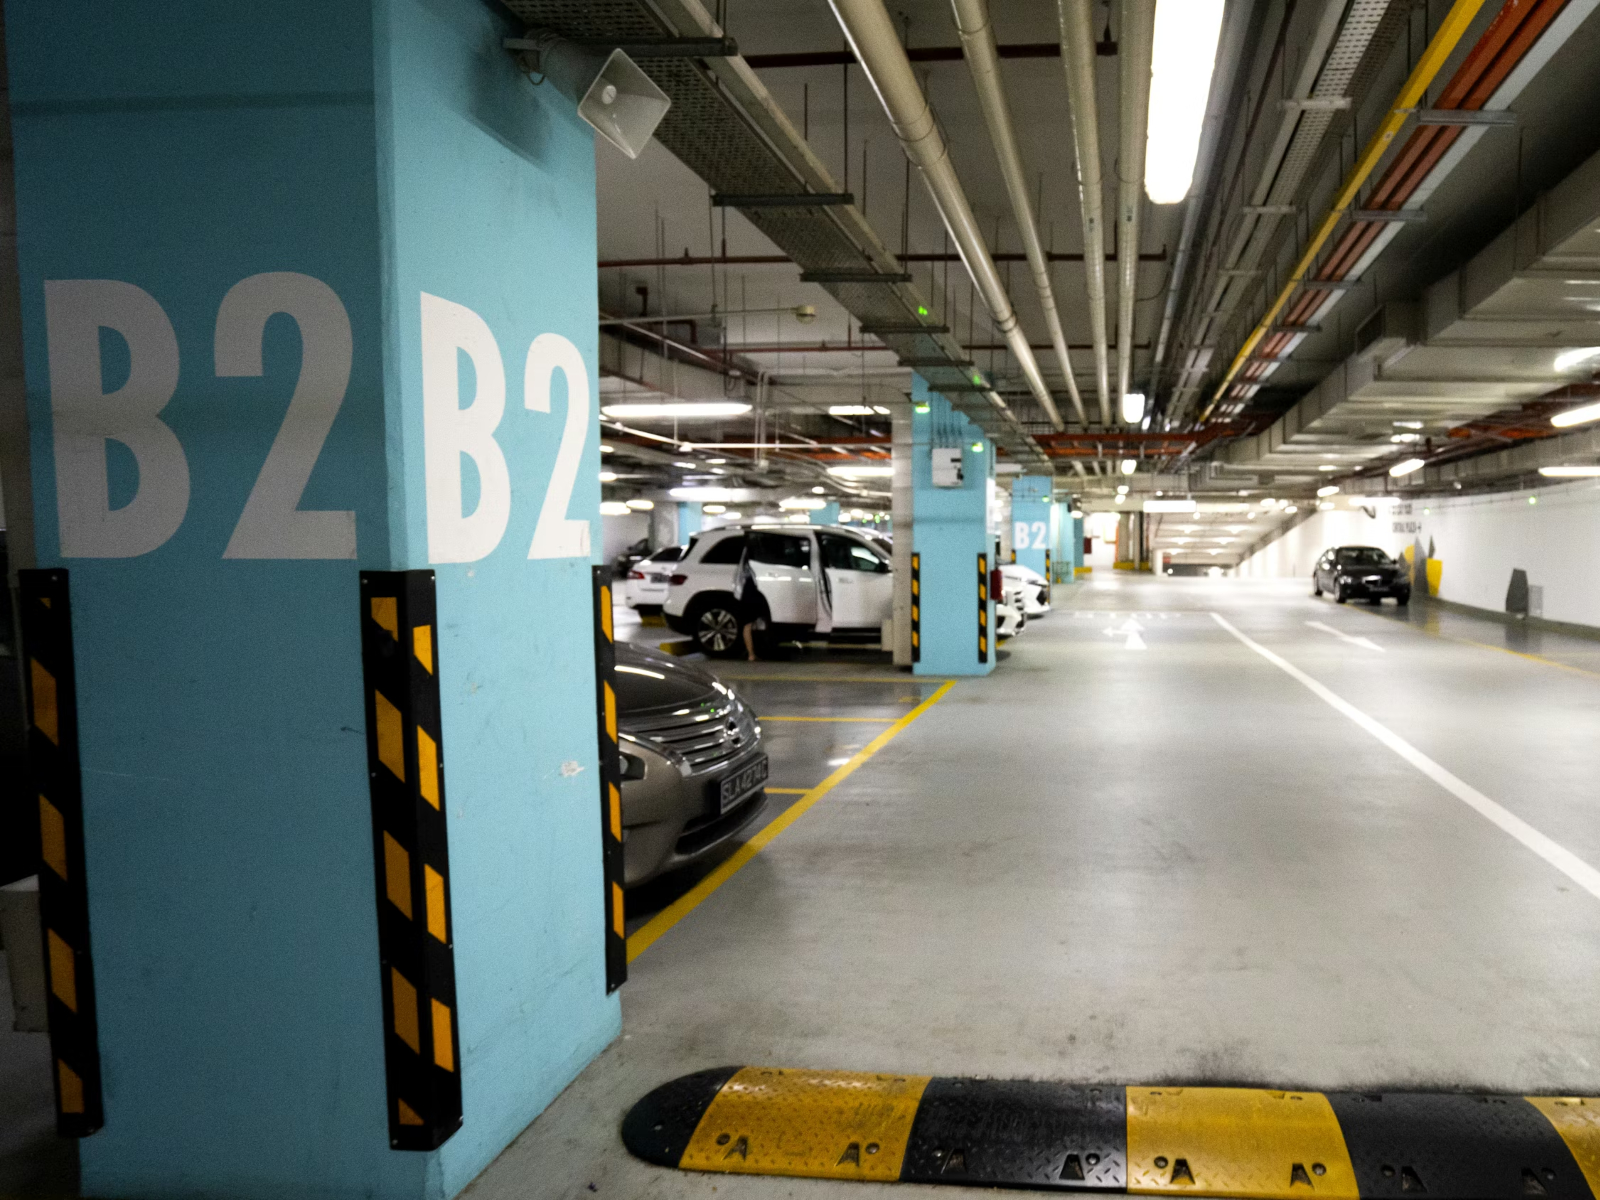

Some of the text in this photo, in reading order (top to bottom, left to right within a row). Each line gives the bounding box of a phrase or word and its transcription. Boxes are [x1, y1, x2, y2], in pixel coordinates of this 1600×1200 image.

[43, 271, 358, 560] B2
[419, 291, 592, 564] B2
[1014, 521, 1047, 550] B2
